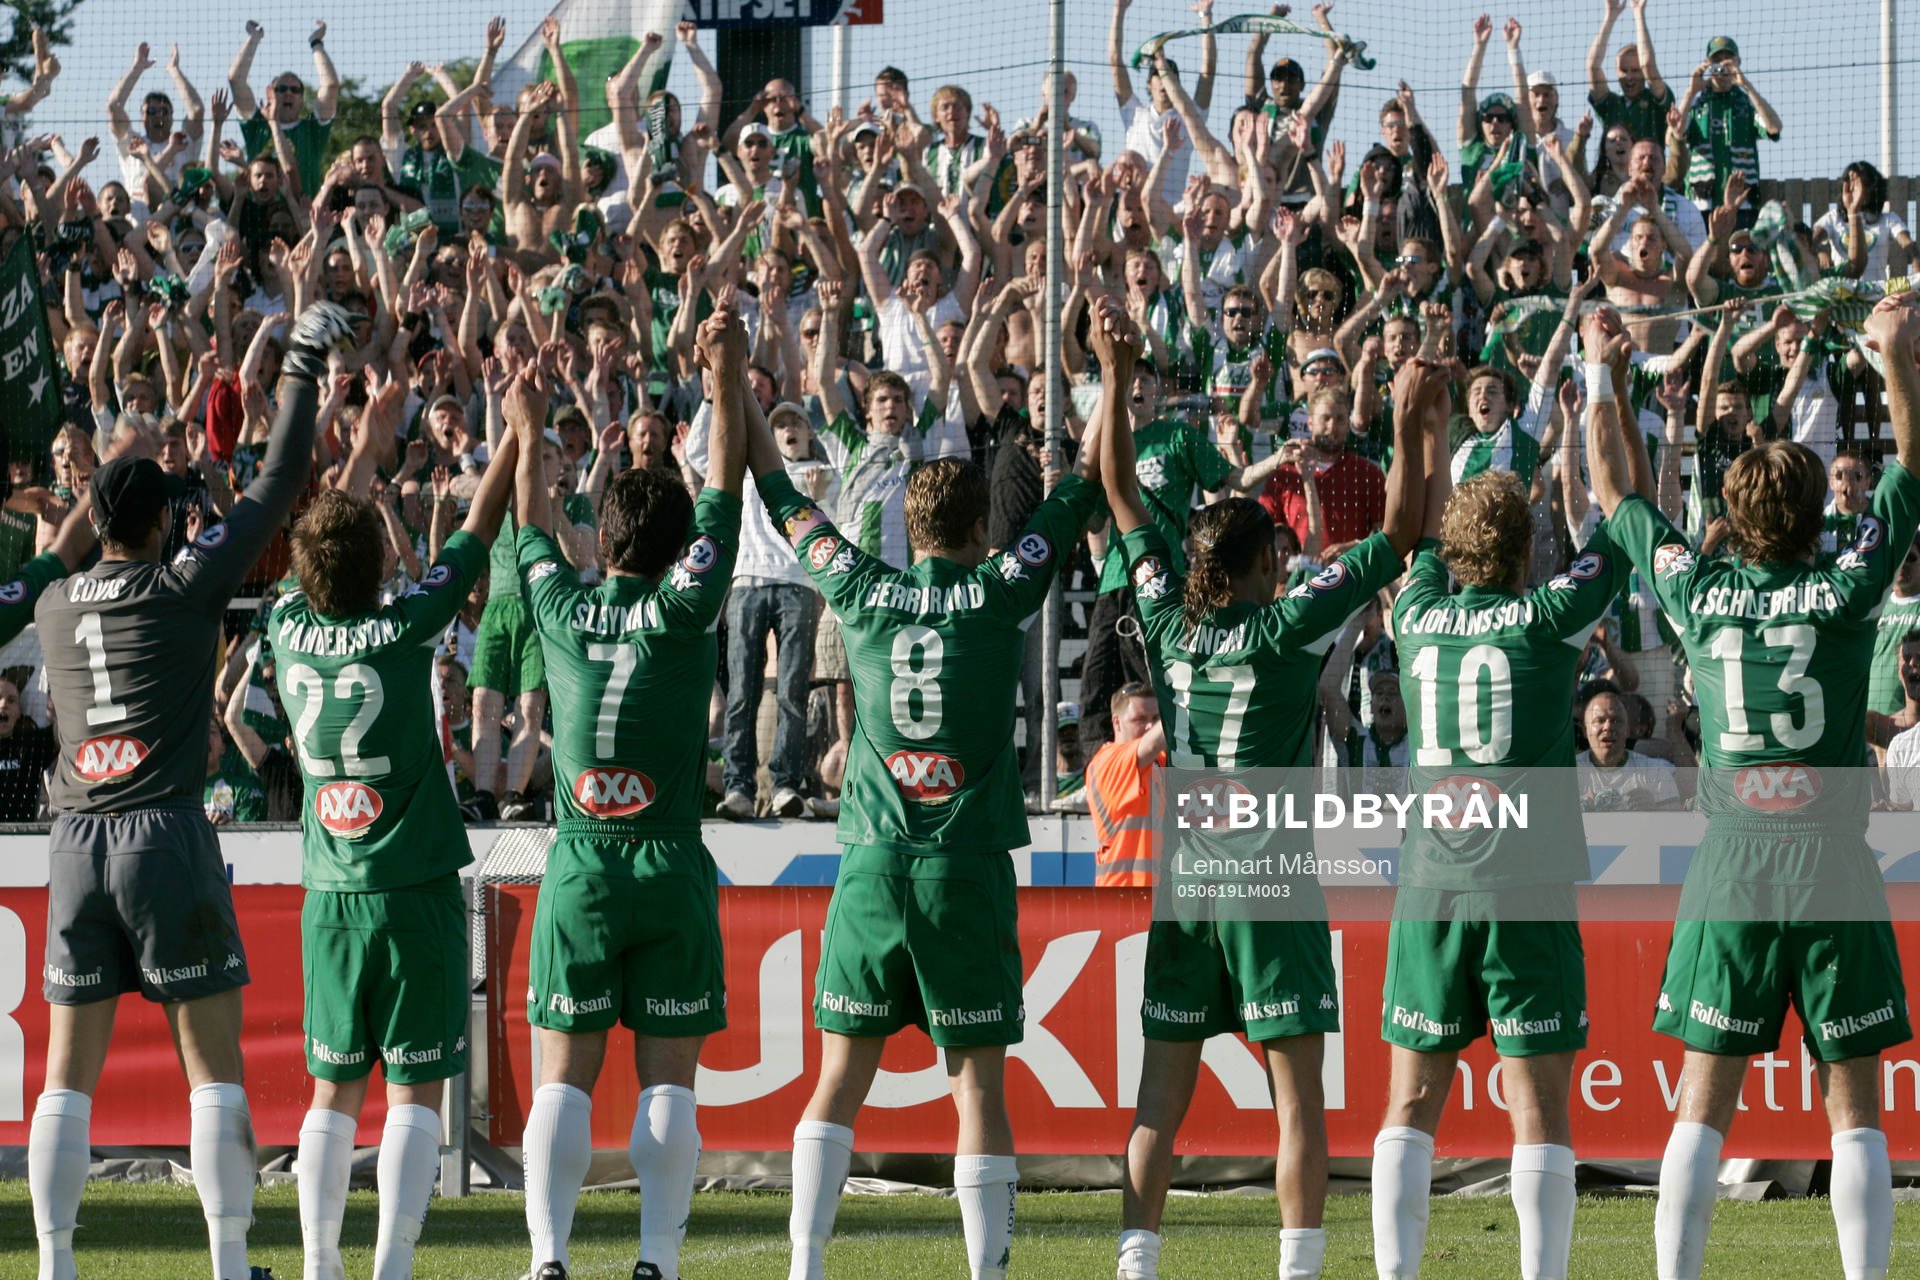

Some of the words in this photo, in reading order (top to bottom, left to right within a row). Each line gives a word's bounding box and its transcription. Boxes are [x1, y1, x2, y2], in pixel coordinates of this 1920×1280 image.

[75, 612, 127, 726] 1
[890, 625, 944, 740] 8
[587, 643, 637, 759] 7
[1711, 624, 1826, 750] 13
[286, 663, 392, 776] 22
[1163, 661, 1256, 773] 17
[1410, 644, 1513, 766] 10
[81, 739, 142, 774] AXA
[890, 754, 957, 788] AXA
[579, 772, 649, 805] AXA
[1742, 765, 1815, 800] AXA
[320, 787, 376, 821] AXA
[822, 991, 889, 1017] Folksam
[930, 1007, 1003, 1027] Folksam
[1144, 998, 1206, 1023] Folksam
[1392, 1006, 1461, 1036] Folksam
[1690, 999, 1760, 1036] Folksam
[1491, 1017, 1561, 1037] Folksam
[1819, 1007, 1896, 1041] Folksam
